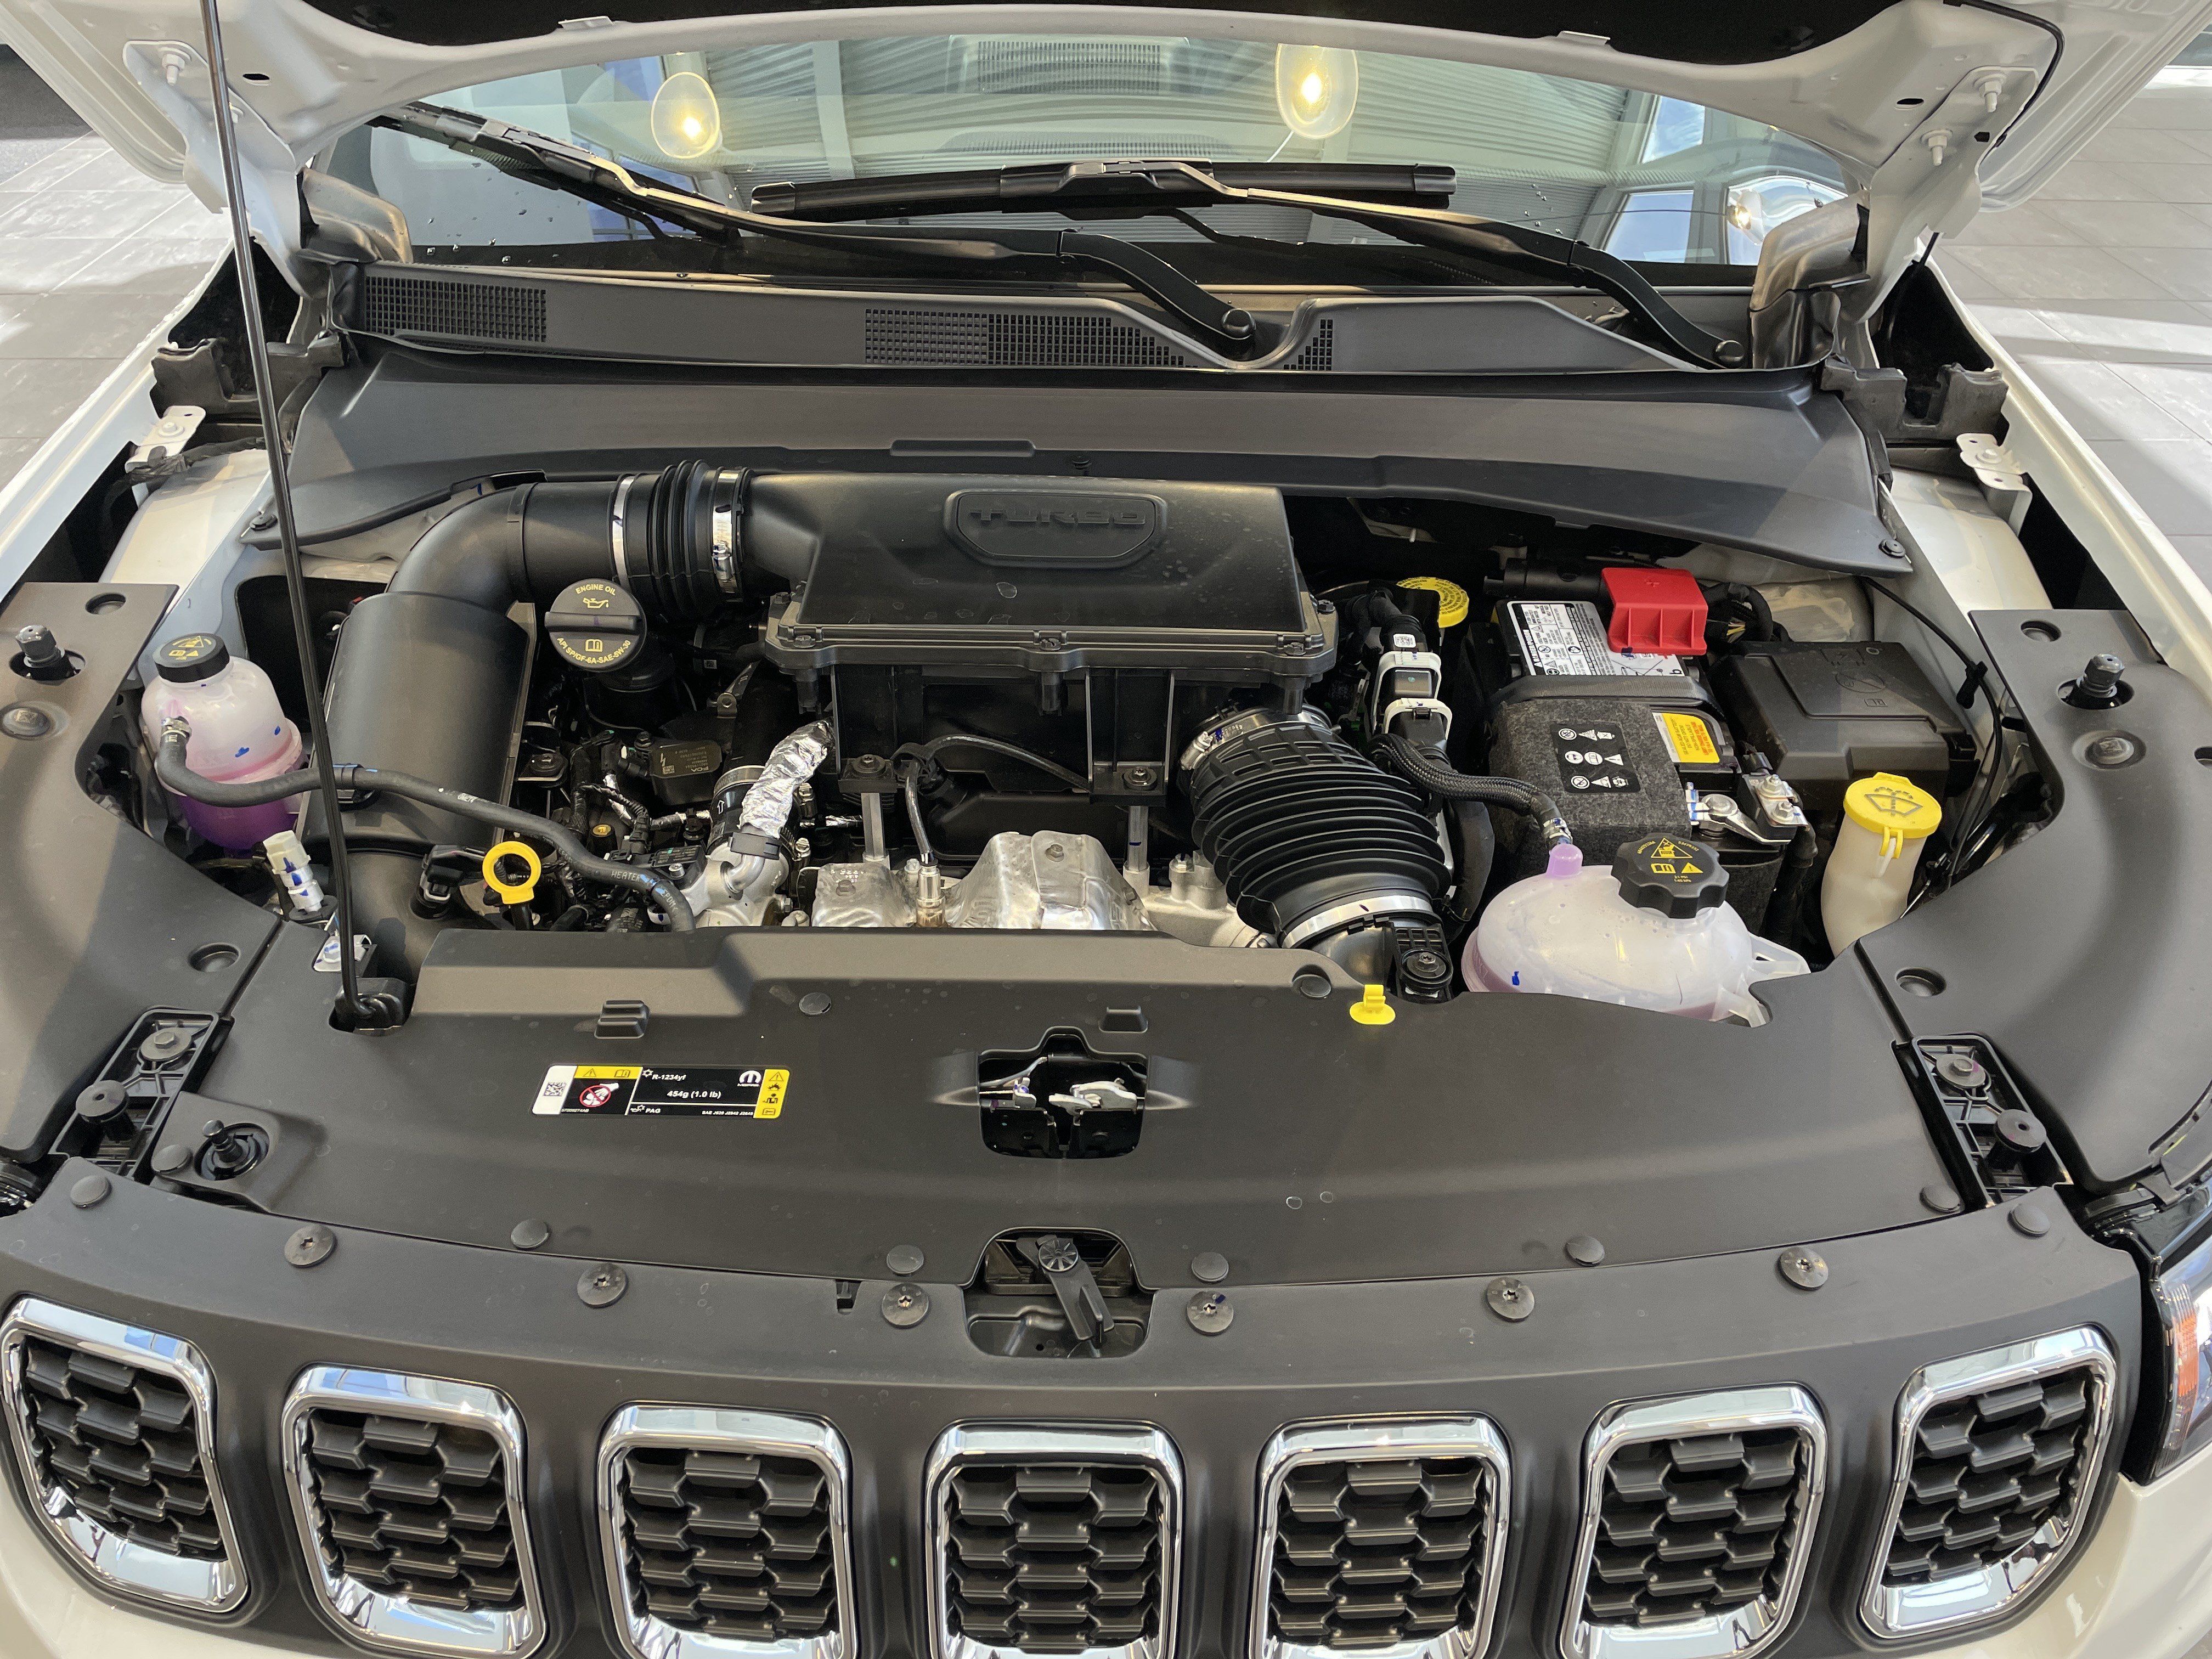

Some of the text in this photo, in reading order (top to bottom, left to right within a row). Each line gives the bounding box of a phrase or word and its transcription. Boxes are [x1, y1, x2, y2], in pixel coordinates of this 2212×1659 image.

[969, 508, 1146, 525] TURBO
[575, 584, 616, 596] ENGINE OIL
[557, 637, 568, 649] API
[667, 1090, 721, 1099] 454g (1.0 lb)
